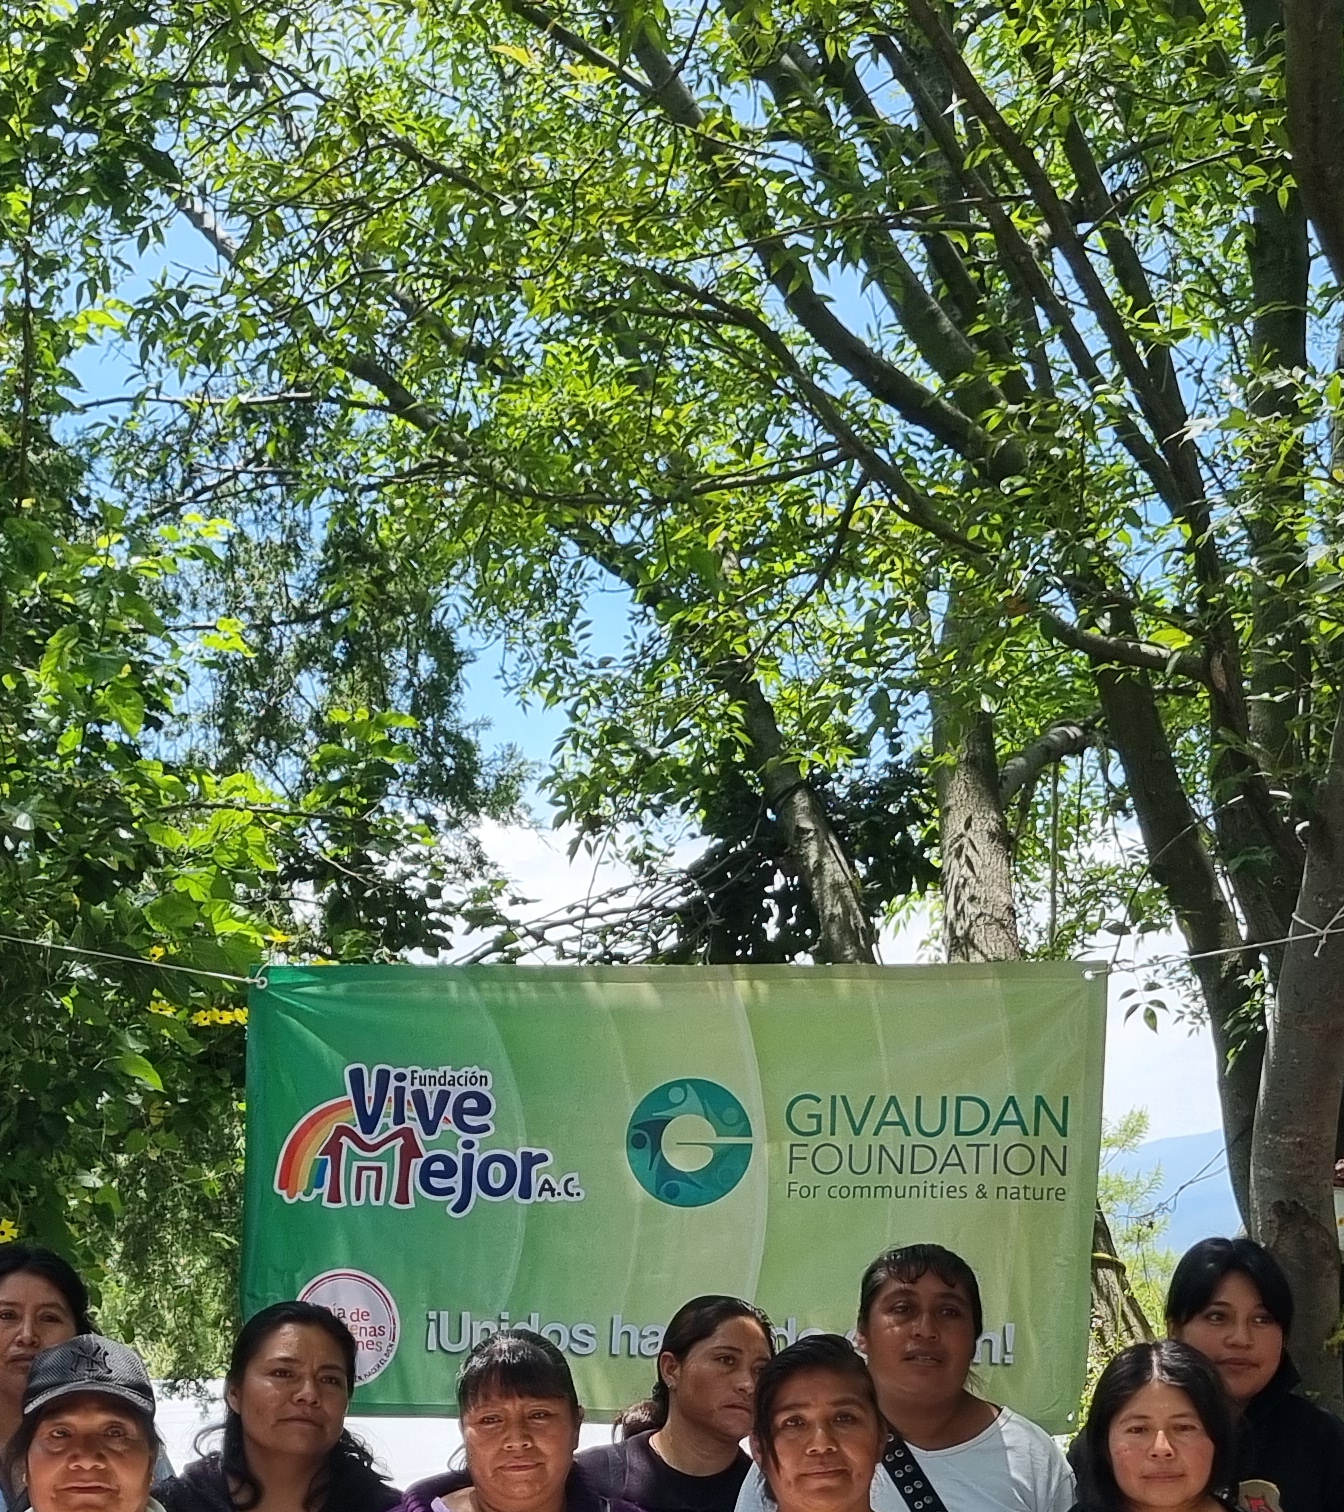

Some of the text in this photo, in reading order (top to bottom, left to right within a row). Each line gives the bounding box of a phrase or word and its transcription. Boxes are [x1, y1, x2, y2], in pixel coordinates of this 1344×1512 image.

[409, 1069, 489, 1088] Fundación
[348, 1066, 493, 1136] Vive
[785, 1093, 1070, 1138] GIVAUDAN
[788, 1142, 1068, 1177] FOUNDATION
[537, 1176, 582, 1198] A.C.
[787, 1180, 1067, 1202] For communities & nature
[349, 1307, 371, 1323] de
